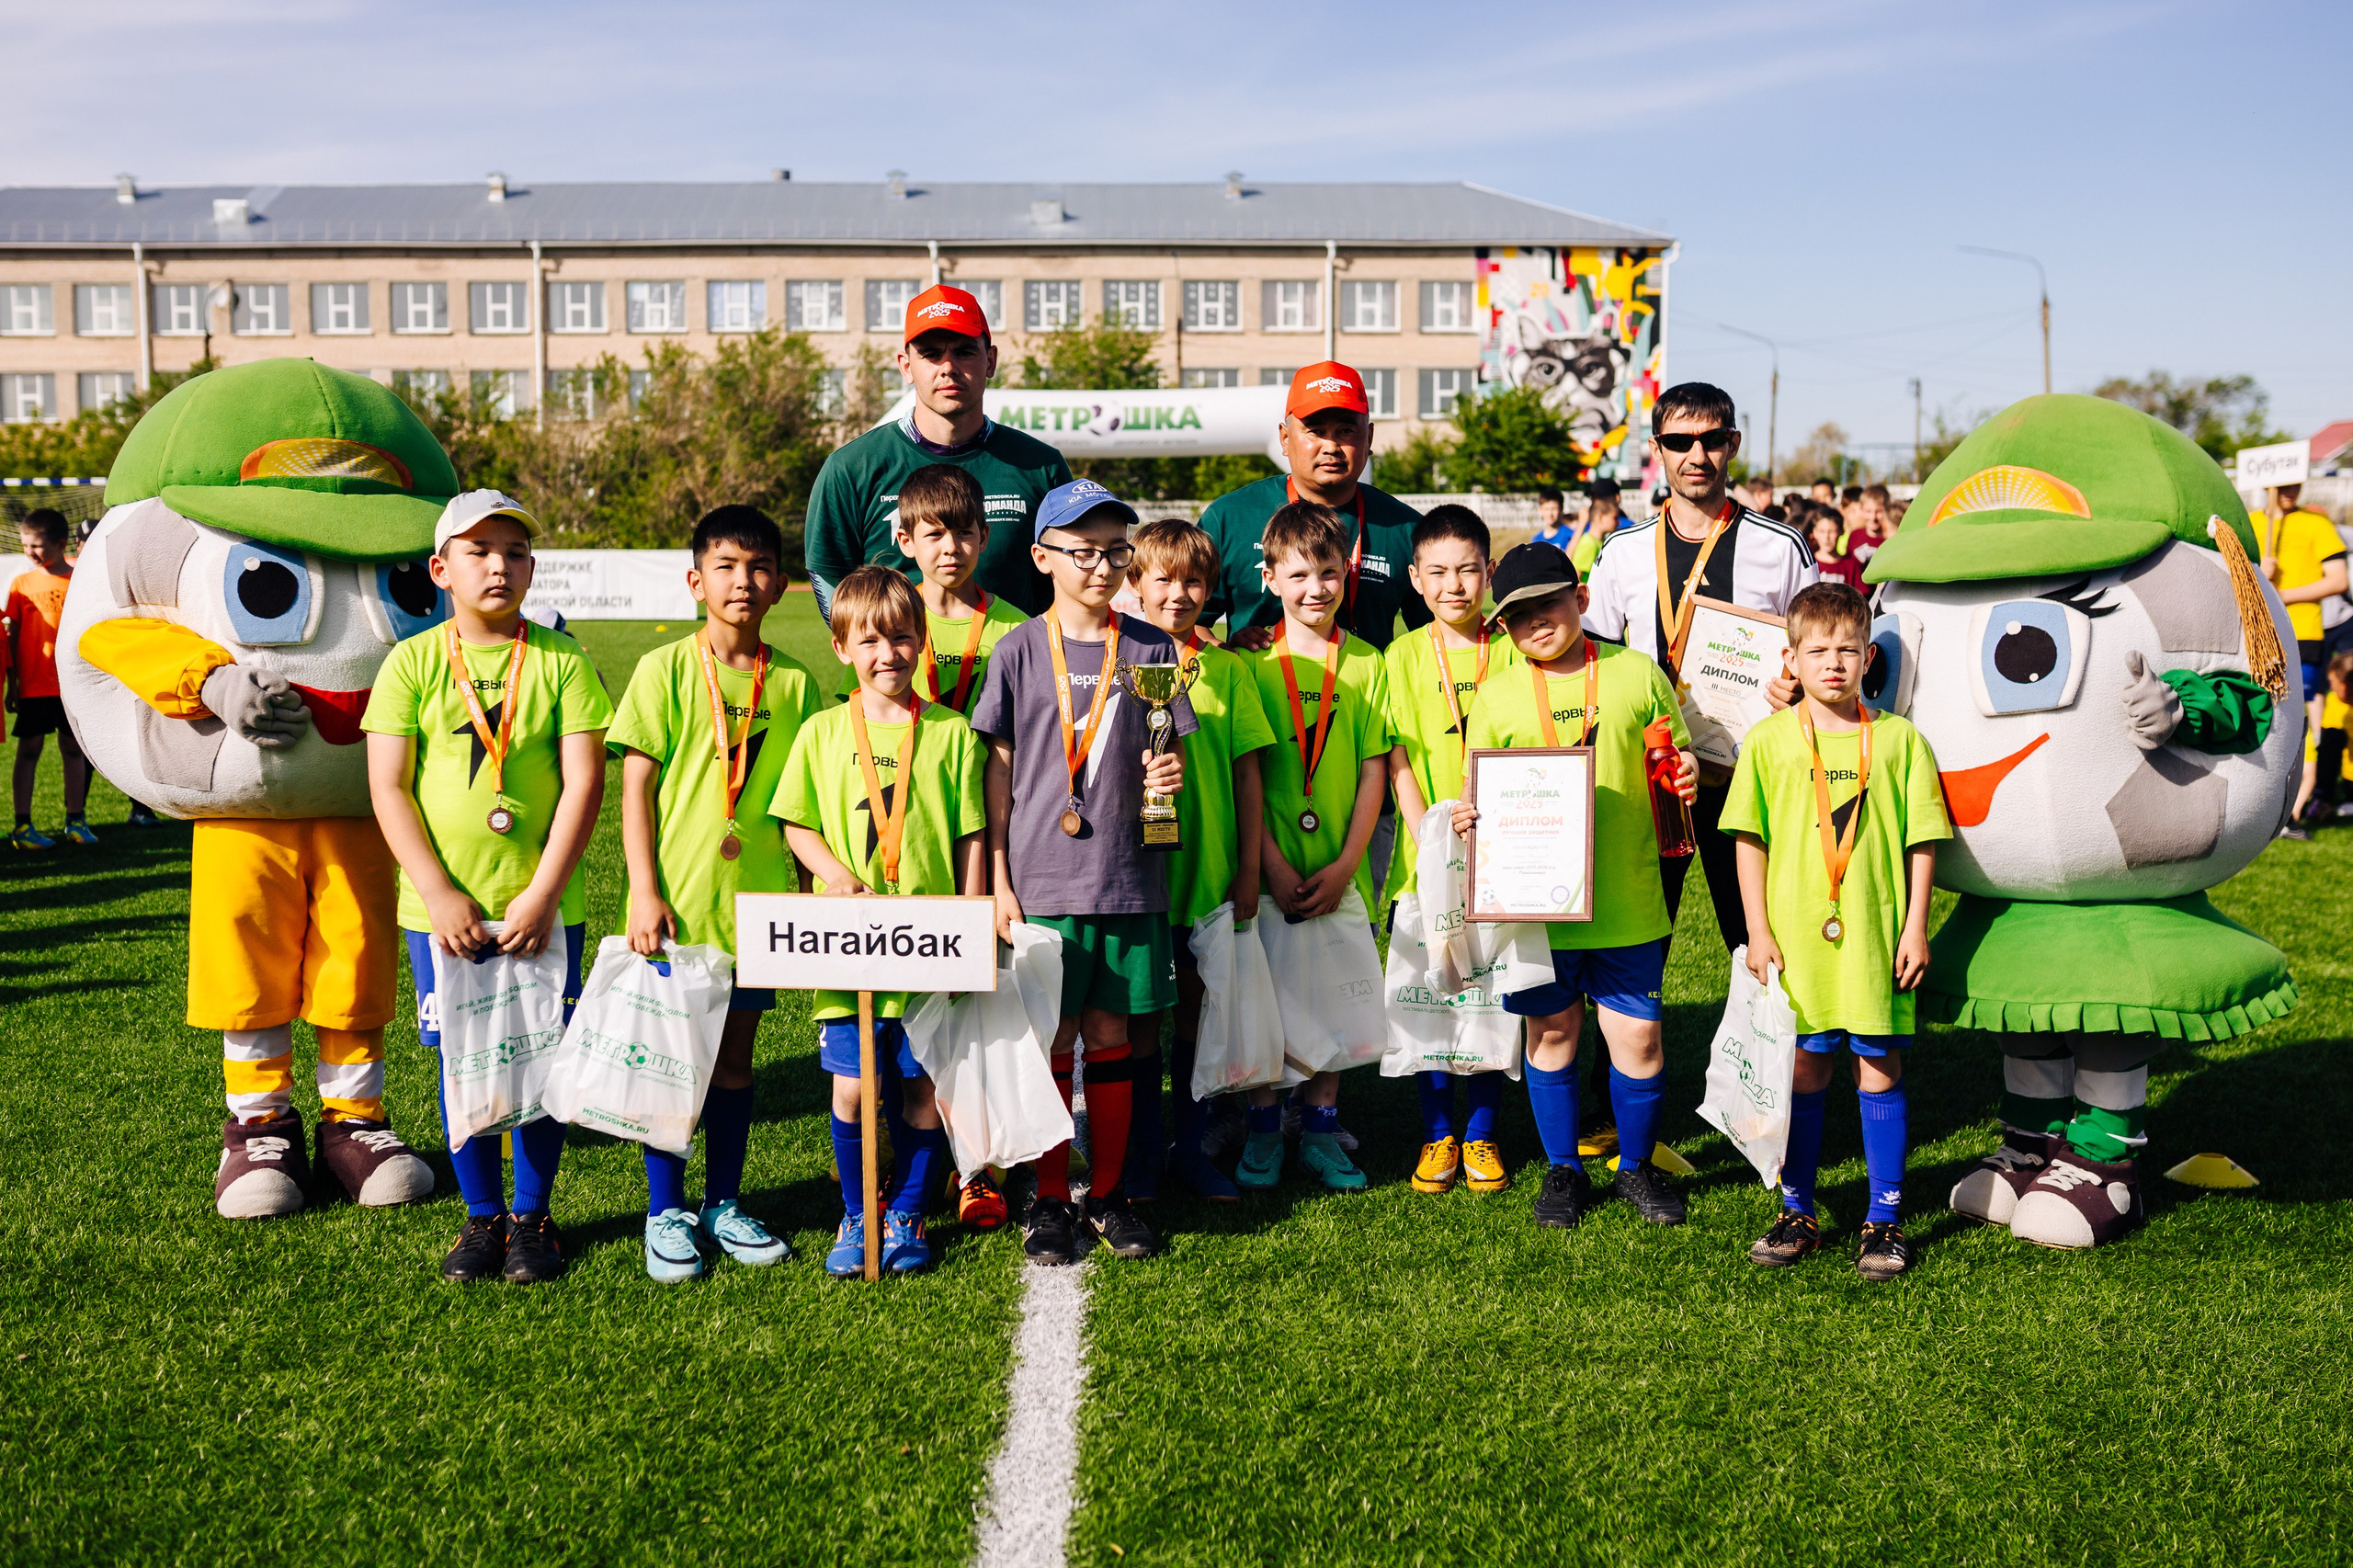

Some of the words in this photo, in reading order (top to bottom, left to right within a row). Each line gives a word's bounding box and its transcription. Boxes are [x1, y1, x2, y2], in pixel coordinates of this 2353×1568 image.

[928, 309, 950, 319] 2025
[1319, 384, 1340, 393] 2025
[2246, 456, 2298, 476] Субутак
[1077, 483, 1103, 493] KIA
[881, 494, 899, 503] Перв
[1068, 494, 1083, 504] KIA
[983, 499, 1027, 515] ОМАНДА
[535, 561, 593, 574] ДДЕРЖКЕ
[1360, 559, 1391, 578] МАНДА
[1692, 559, 1706, 577] 2025
[532, 579, 570, 590] АТОРА
[523, 595, 576, 608] БИНСКОЙ
[580, 596, 632, 608] ОБЛАСТИ
[933, 651, 982, 666] ерве
[1720, 653, 1745, 667] 2025
[1067, 672, 1121, 688] Перве
[1700, 665, 1758, 687] ДИПЛОМ
[453, 678, 507, 689] рвые
[1058, 675, 1068, 692] 2025
[1287, 689, 1340, 703] ерве
[1720, 687, 1741, 697] МЕСТО
[1586, 705, 1595, 722] 2025
[1516, 798, 1543, 809] 2025
[1498, 815, 1563, 828] ДИПЛОМ
[768, 921, 962, 958] Нагайбак
[577, 1028, 697, 1085] МЕТРОШКА
[582, 1108, 650, 1134] METROSHKA.RU
